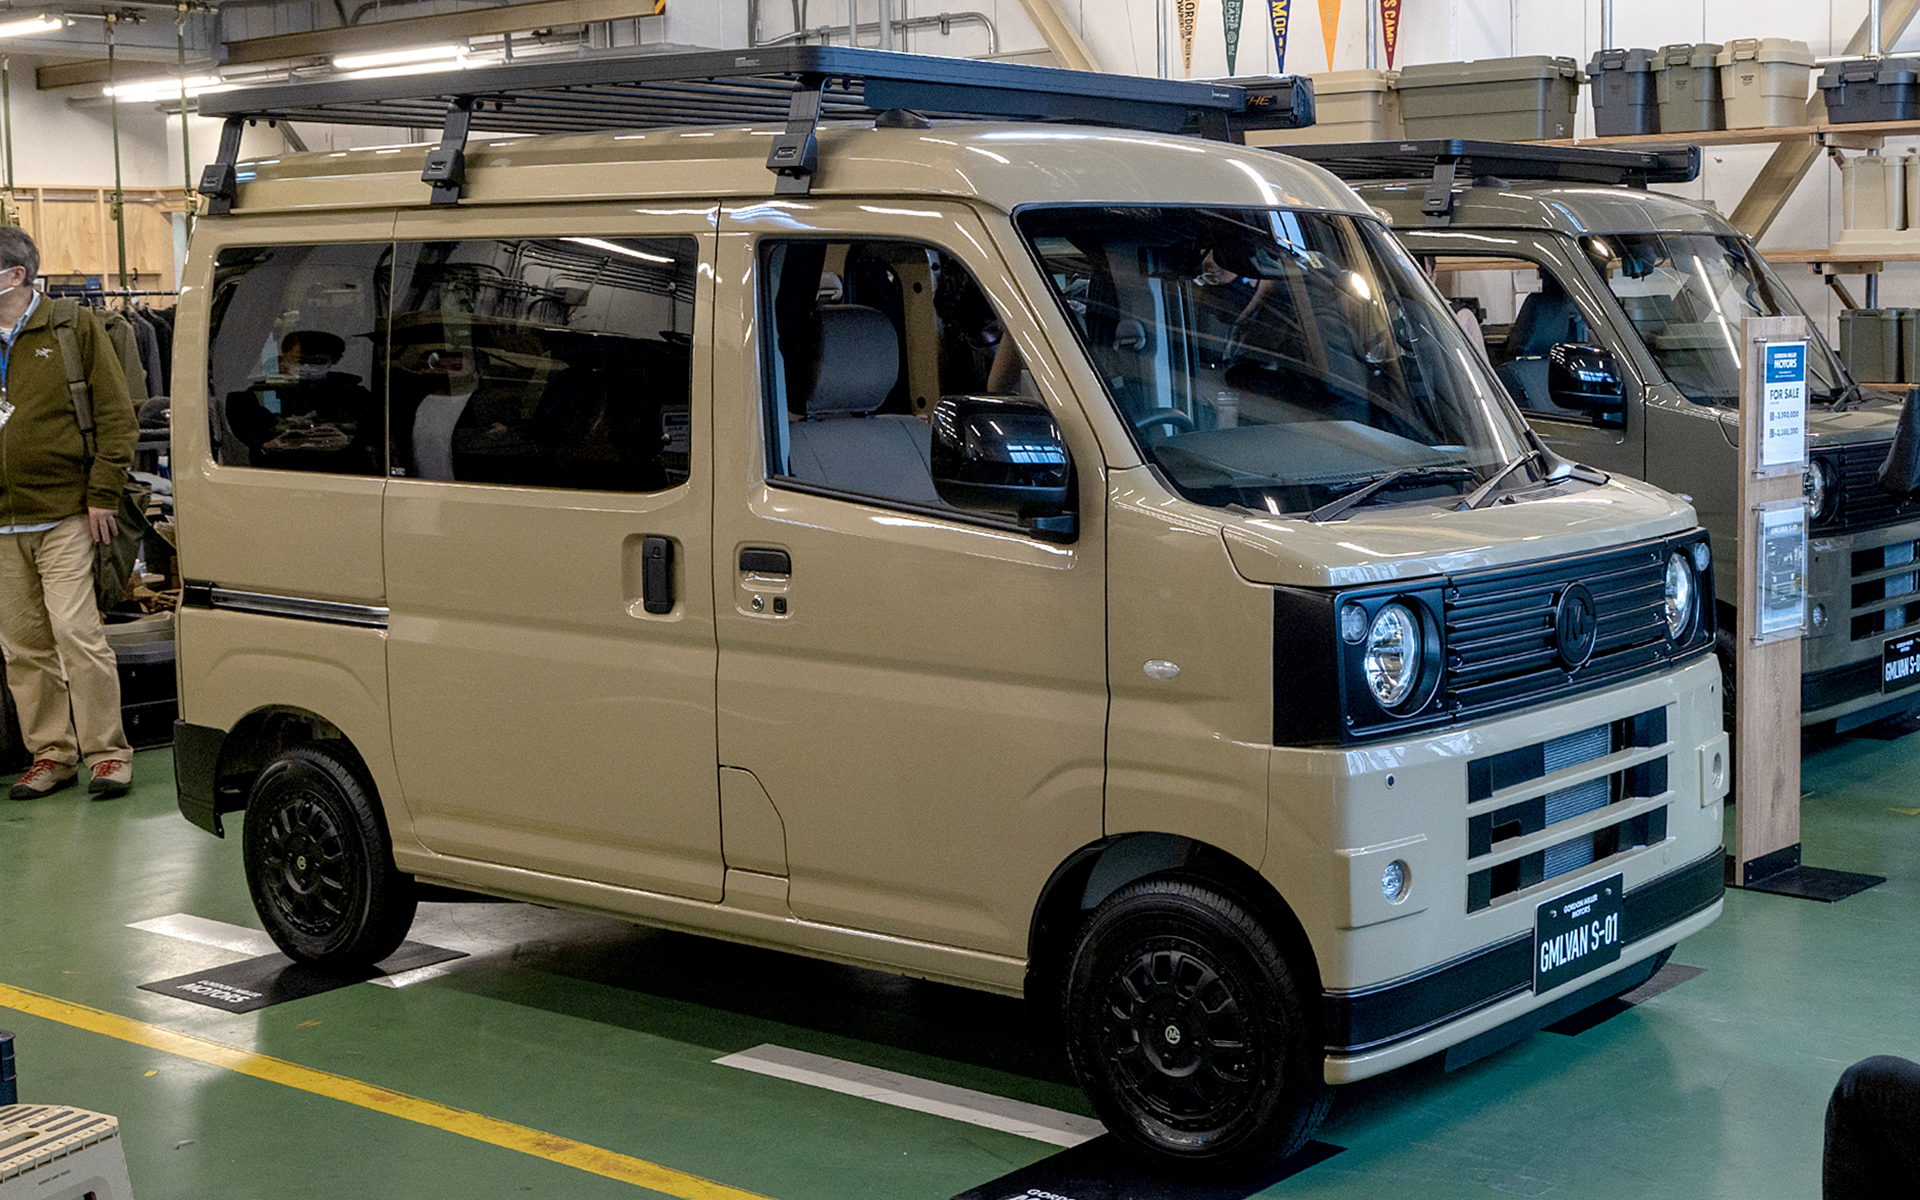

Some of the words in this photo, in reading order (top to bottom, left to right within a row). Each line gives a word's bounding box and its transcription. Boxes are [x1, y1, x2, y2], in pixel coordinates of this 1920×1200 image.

[1184, 0, 1196, 37] ORDON
[1227, 1, 1235, 30] CAMP
[1272, 0, 1288, 36] MOC
[1384, 10, 1397, 45] CAMP
[1245, 95, 1273, 106] HE
[1770, 389, 1783, 400] FOR
[1784, 388, 1799, 399] SALE
[1540, 924, 1589, 973] GMLVAN
[1591, 912, 1618, 951] S-01
[176, 982, 251, 1003] MOTORS
